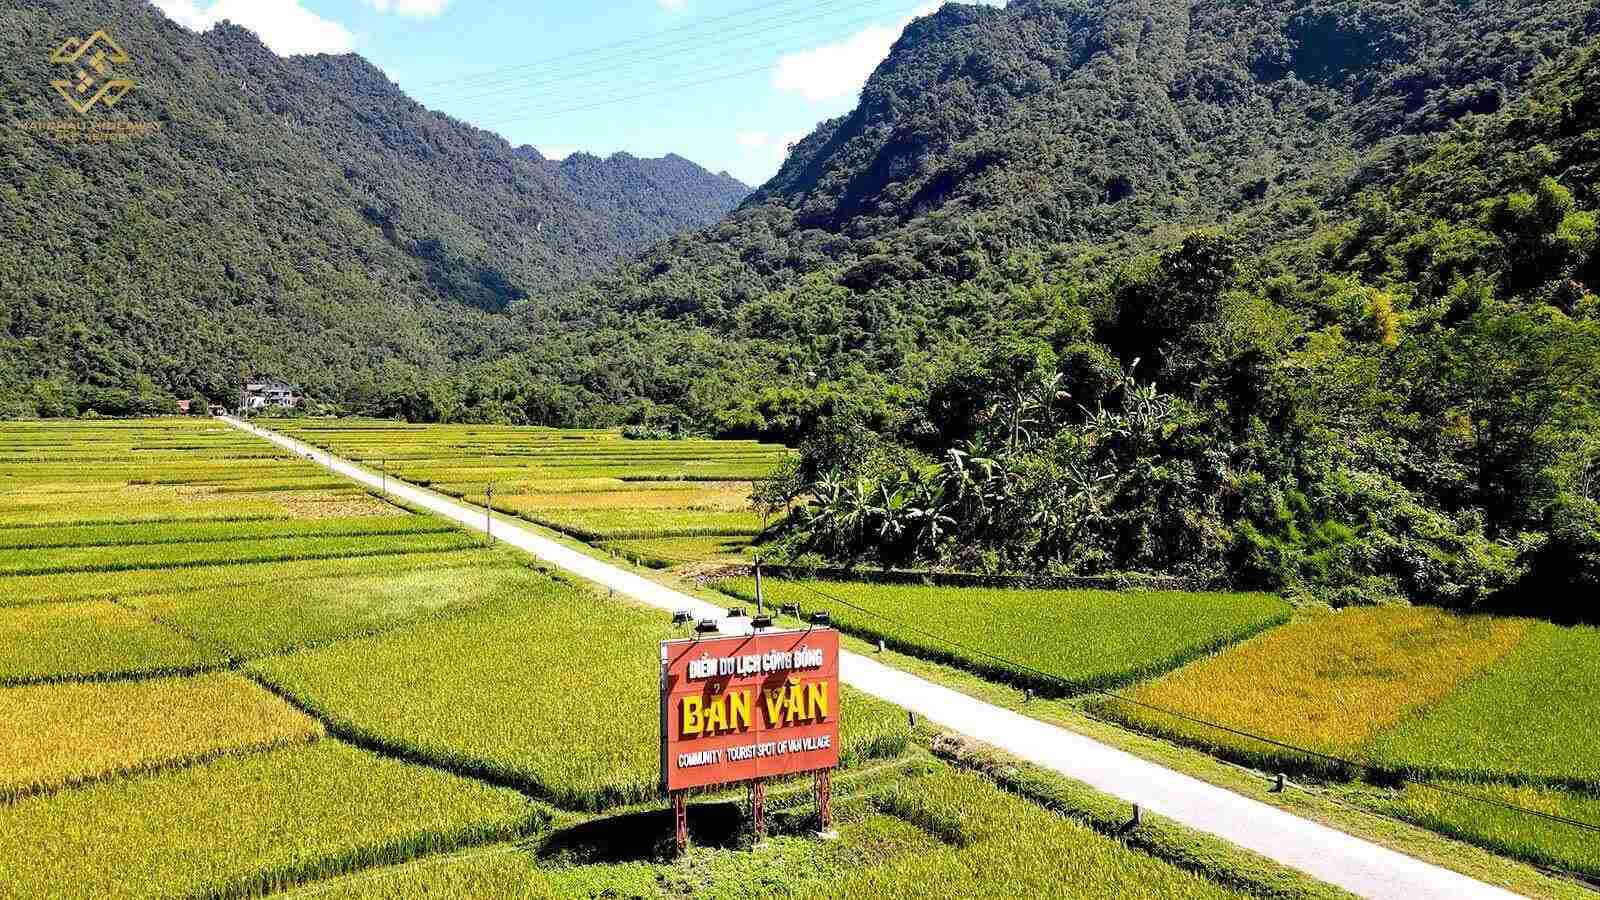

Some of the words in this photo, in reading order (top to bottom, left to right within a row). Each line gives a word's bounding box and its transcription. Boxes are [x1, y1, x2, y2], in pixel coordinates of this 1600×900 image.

[719, 656, 736, 676] DU
[736, 654, 761, 677] LỊCH
[762, 650, 791, 674] CỘNG
[682, 683, 753, 735] BẢN
[764, 676, 829, 725] VĂN
[678, 750, 722, 768] COMMUNITY
[726, 746, 756, 761] TOURIST
[757, 743, 777, 757] SPOT
[777, 741, 788, 755] OF
[788, 739, 802, 753] VAN
[801, 735, 831, 752] VILLAGE
